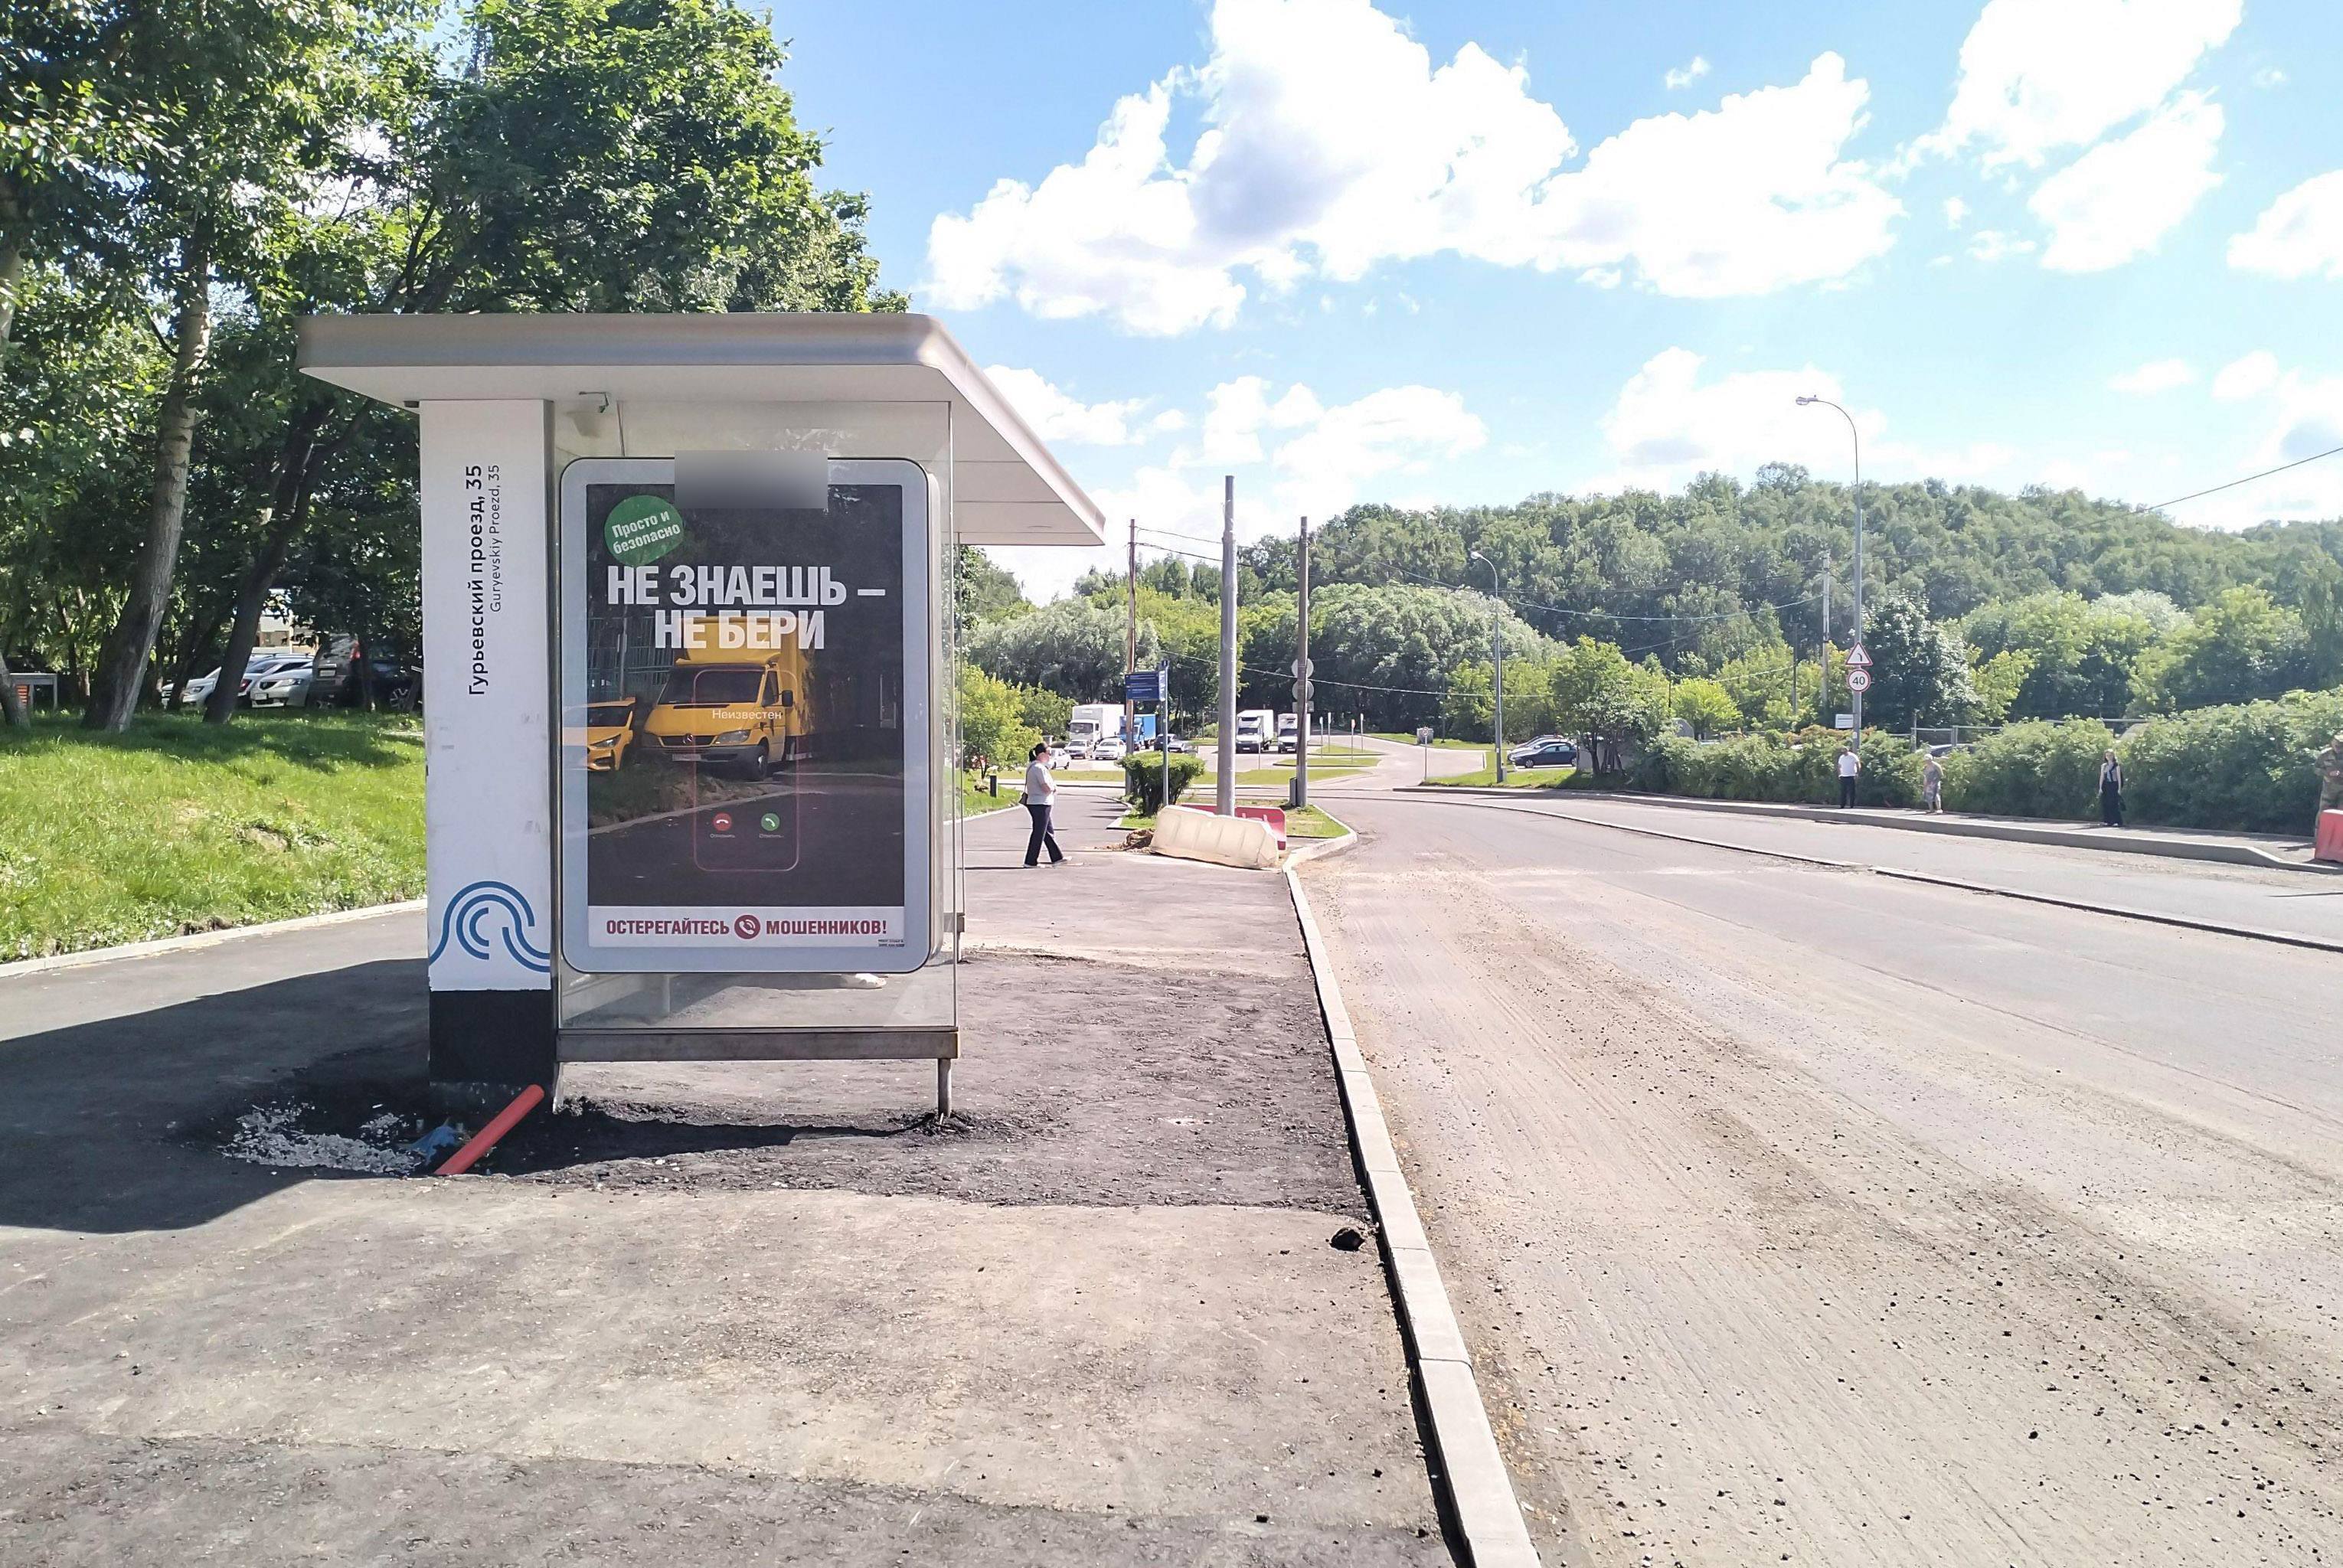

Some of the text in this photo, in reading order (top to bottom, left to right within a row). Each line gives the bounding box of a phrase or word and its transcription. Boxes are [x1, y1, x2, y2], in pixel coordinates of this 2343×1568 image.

[488, 465, 503, 612] Guryevskiy Proezd, 35
[612, 515, 658, 538] Просто
[613, 524, 681, 554] безопасно
[466, 466, 489, 694] Гурьевский проезд, 35
[608, 565, 659, 605] НЕ
[670, 564, 847, 606] ЗНАЕШЬ
[655, 609, 825, 649] НЕ БЕРИ
[1852, 676, 1865, 685] 40
[712, 709, 782, 720] Неизвестен
[606, 918, 887, 935] ОСТЕРЕГАЙТЕСЬ МОШЕННИКОВ!
